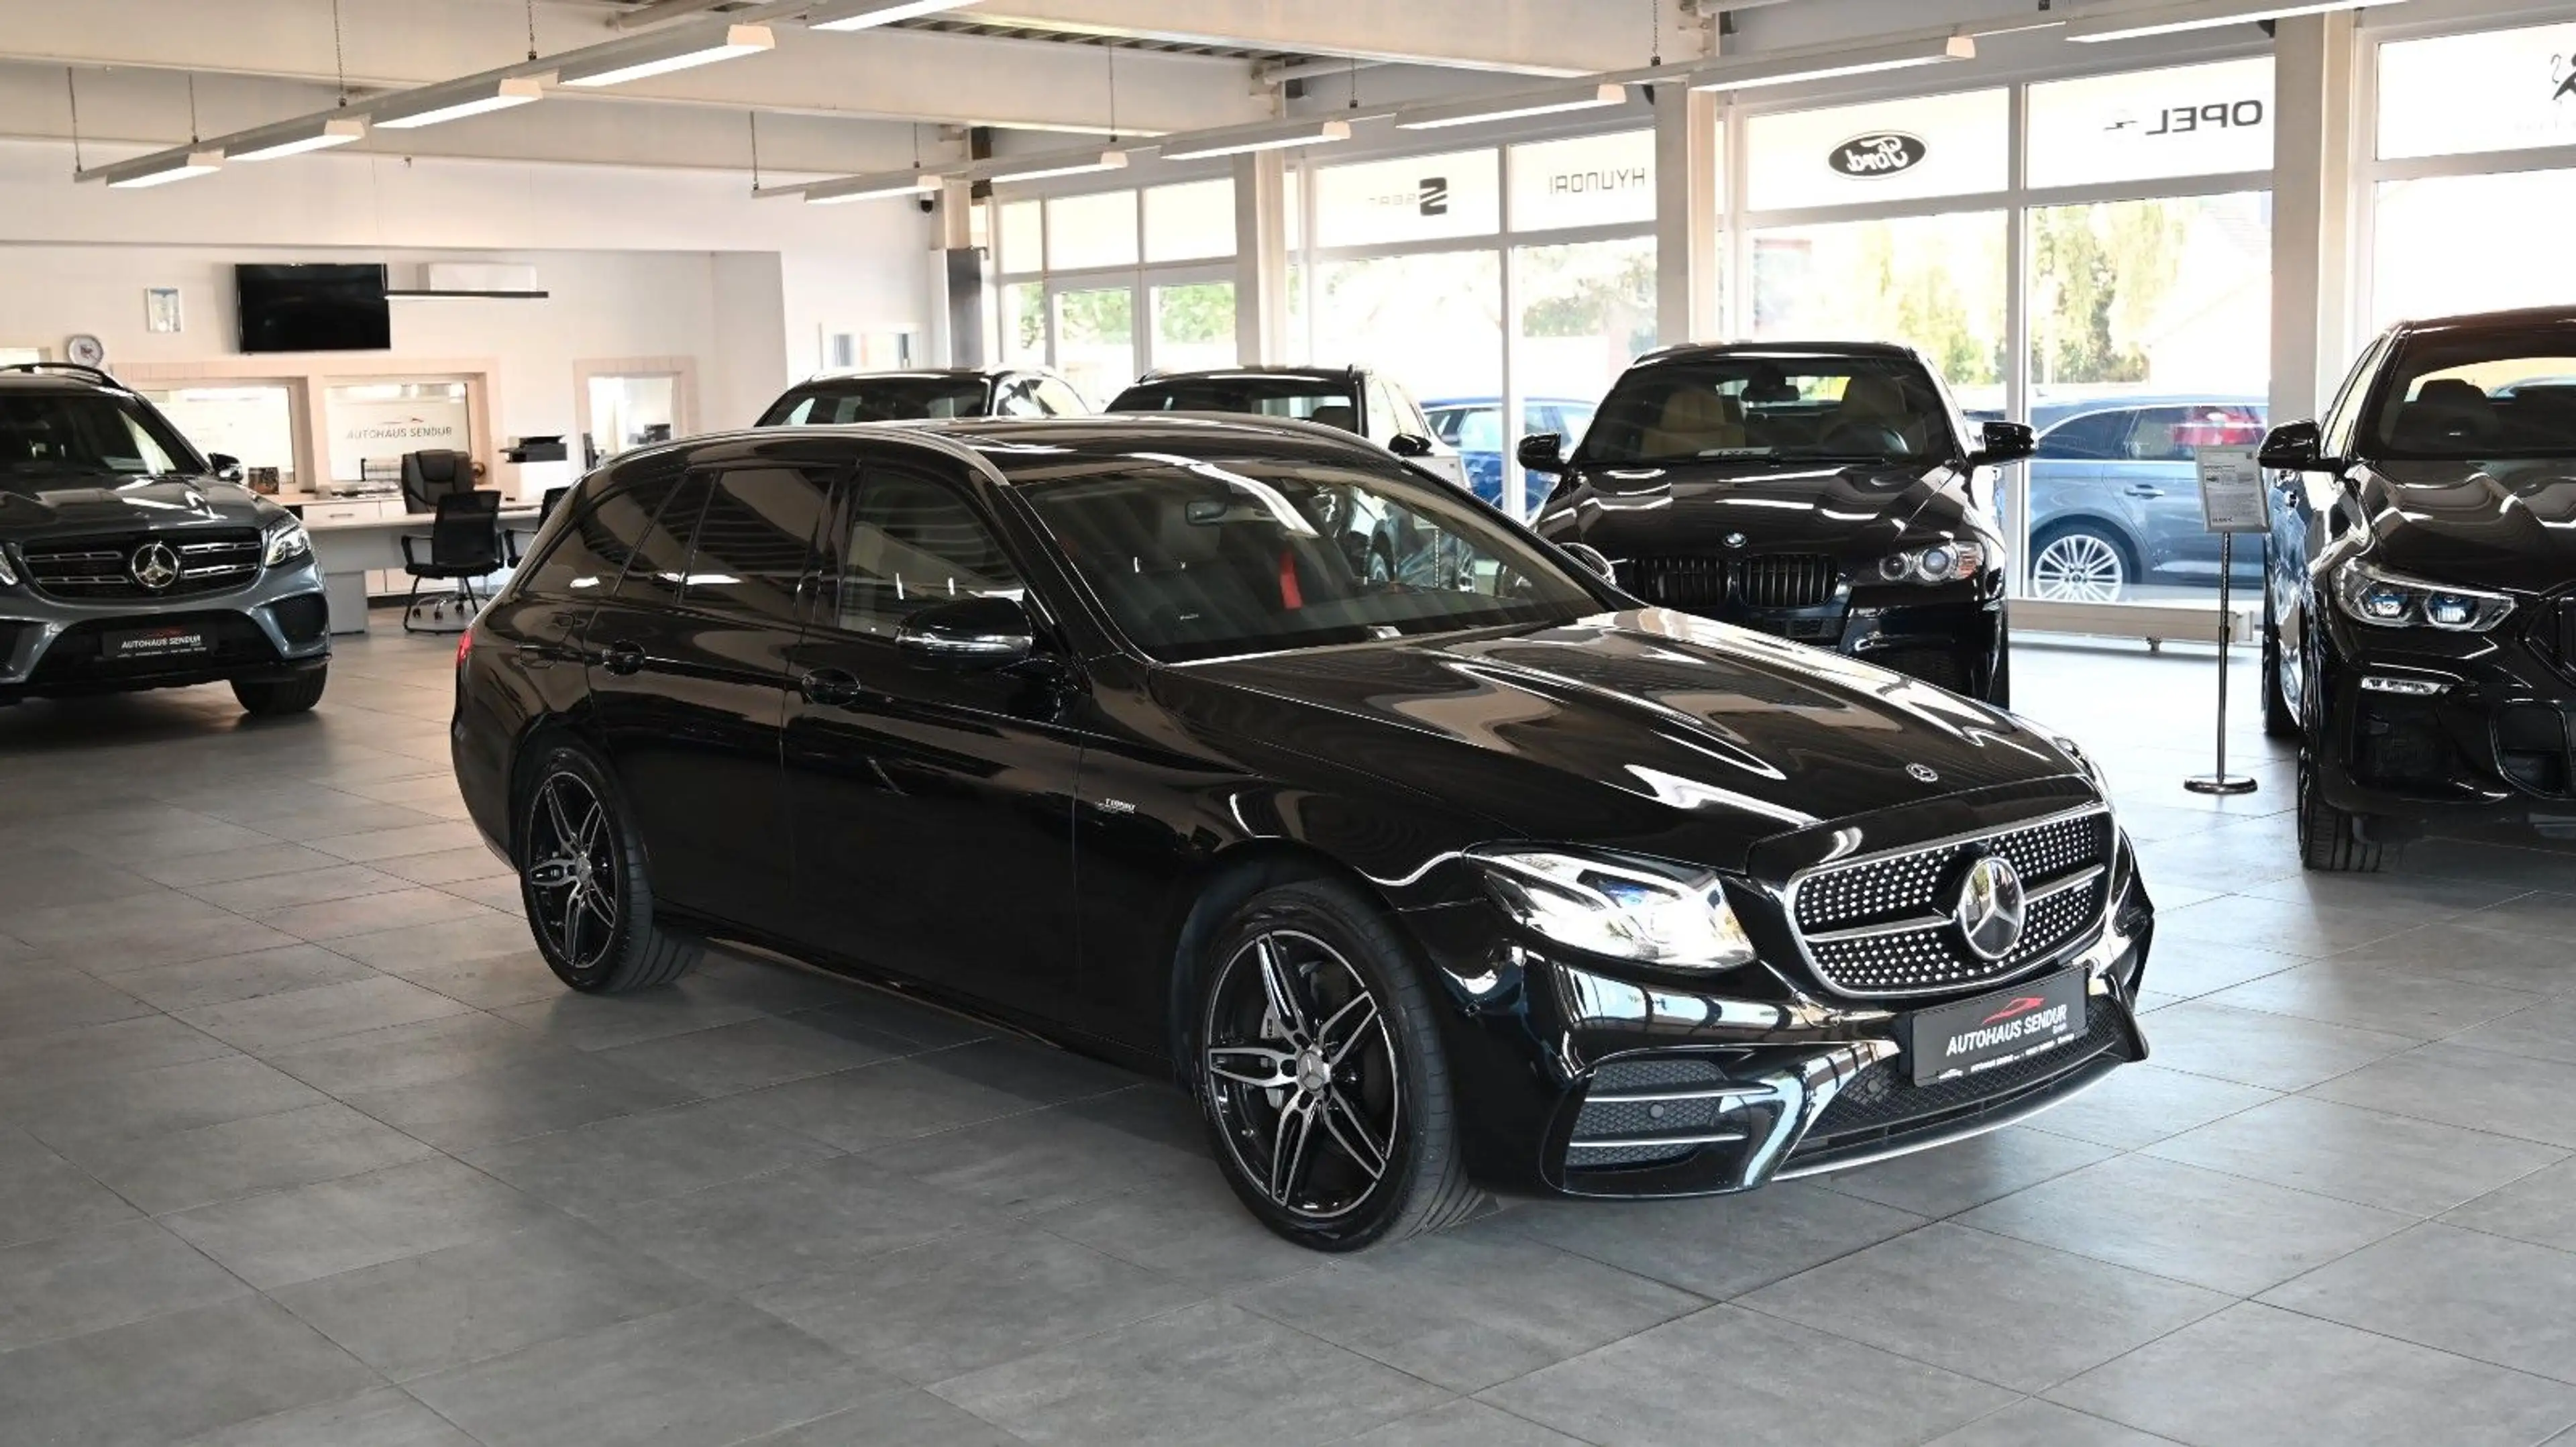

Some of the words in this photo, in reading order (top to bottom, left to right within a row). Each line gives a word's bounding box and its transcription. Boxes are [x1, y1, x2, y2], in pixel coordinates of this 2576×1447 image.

[346, 427, 407, 440] AUTOHAUS
[121, 637, 167, 649] AUTOHAUS
[169, 634, 201, 645] SENDUR
[1945, 1020, 2022, 1057] AUTOHAUS
[2023, 1004, 2068, 1035] SENDUR
